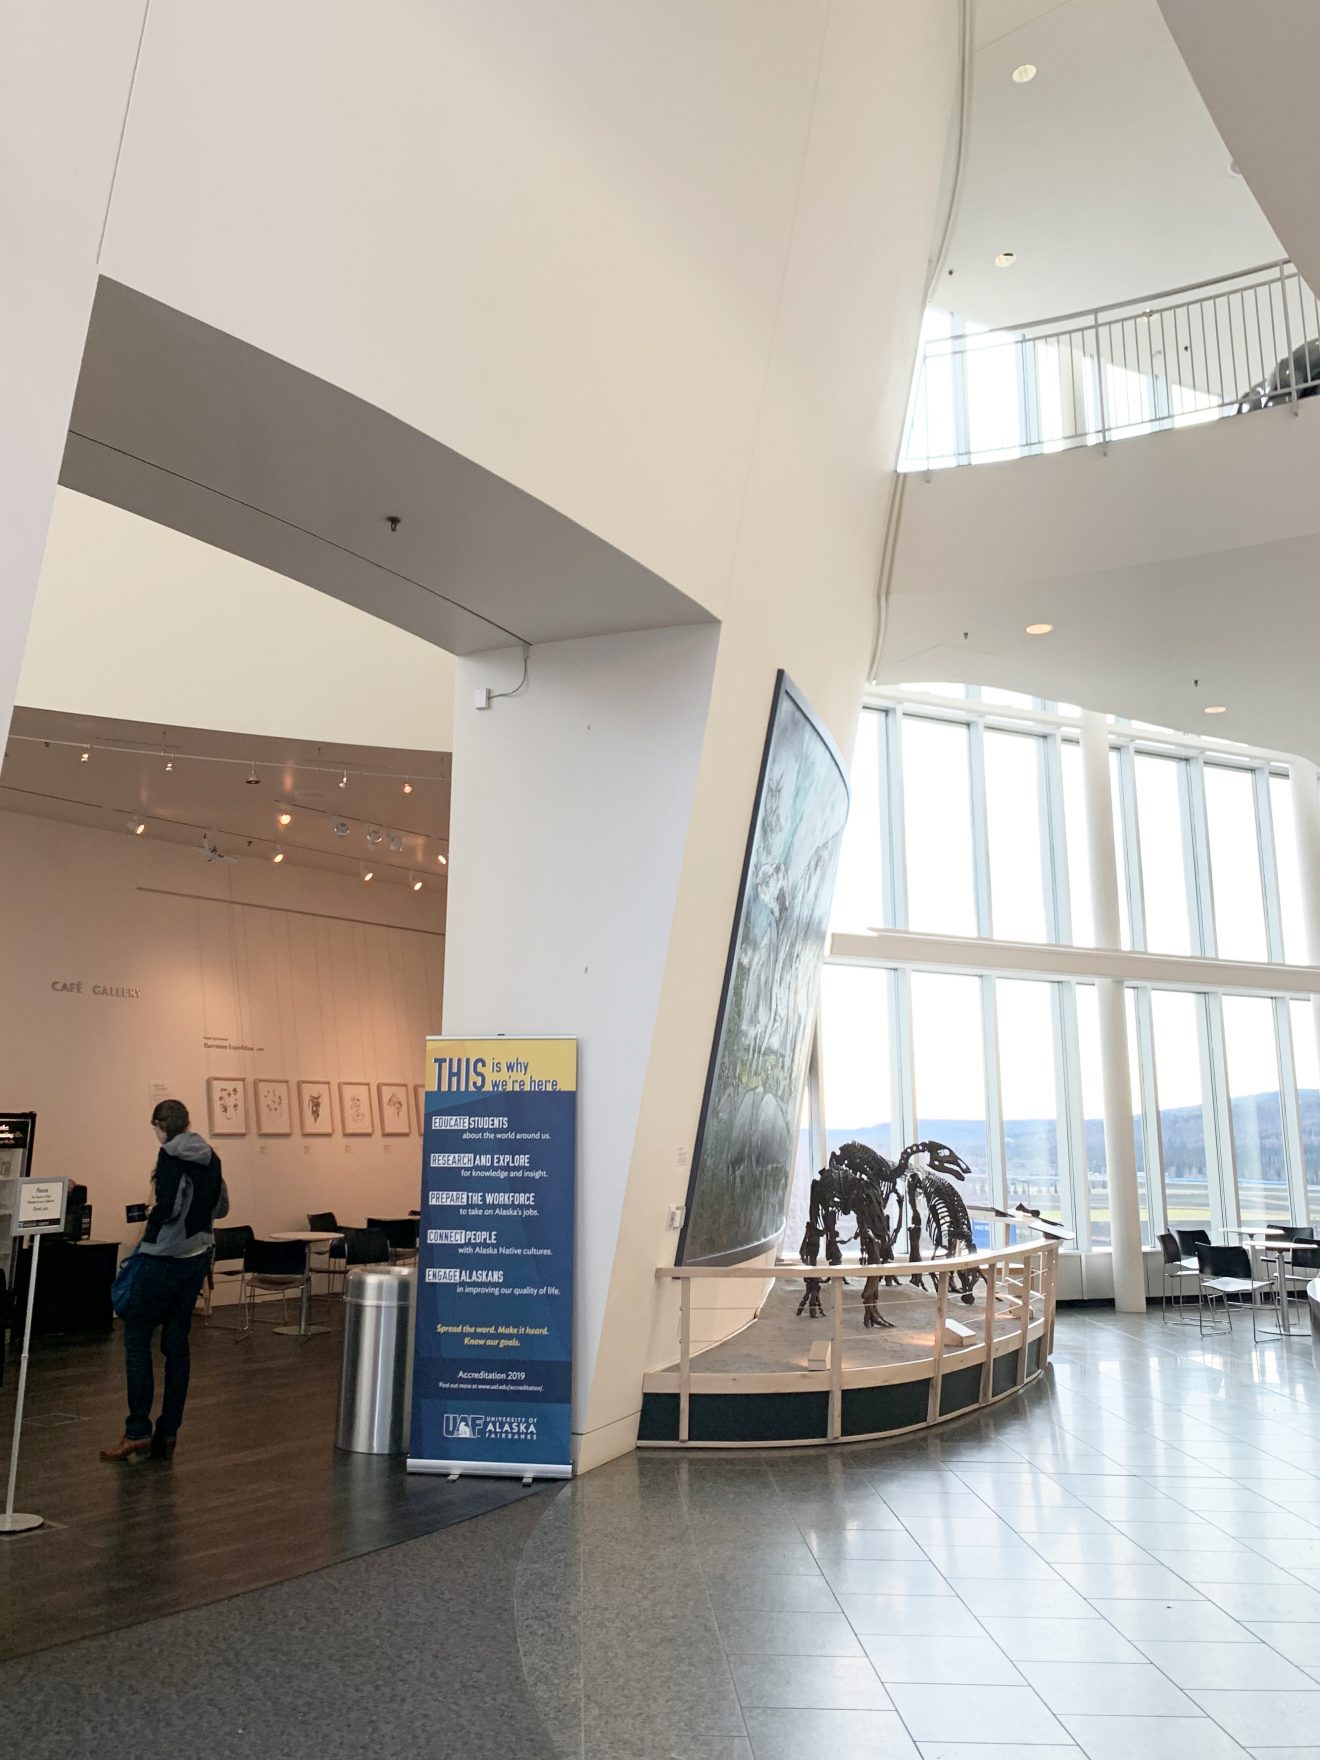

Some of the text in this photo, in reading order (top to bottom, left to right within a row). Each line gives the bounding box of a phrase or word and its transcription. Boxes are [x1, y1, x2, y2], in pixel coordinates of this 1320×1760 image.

[51, 981, 141, 999] CAFÉ GALLERY
[433, 1057, 529, 1091] THIS is why
[491, 1075, 562, 1091] we're here.
[432, 1116, 508, 1129] EDUCATE STUDENTS
[462, 1131, 482, 1139] about
[496, 1131, 515, 1139] world
[516, 1131, 540, 1139] around
[431, 1154, 530, 1167] RESEARCH AND EXPLORE
[461, 1169, 471, 1177] for
[472, 1169, 508, 1179] knowledge
[523, 1170, 548, 1179] insight.
[430, 1192, 535, 1205] PREPARE THE WORKFORCE
[459, 1208, 467, 1216] to
[468, 1208, 483, 1216] take
[494, 1208, 521, 1216] Alaska's
[522, 1208, 540, 1218] jobs.
[428, 1230, 497, 1243] CONNECT PEOPLE
[458, 1247, 553, 1256] with Alaska Native cultures.
[427, 1268, 504, 1282] ENGAGE ALASKANS
[456, 1285, 464, 1293] in
[465, 1285, 500, 1295] improving
[513, 1286, 537, 1296] quality
[538, 1286, 547, 1295] of
[547, 1286, 560, 1295] life.
[436, 1324, 549, 1335] Spread the word. Make it heard.
[464, 1337, 485, 1345] Know
[499, 1338, 520, 1348] goals.
[457, 1371, 526, 1381] Accreditation 2019
[443, 1414, 485, 1438] UAF
[486, 1422, 537, 1434] ALASKA
[485, 1432, 537, 1440] FAIRBANKS
